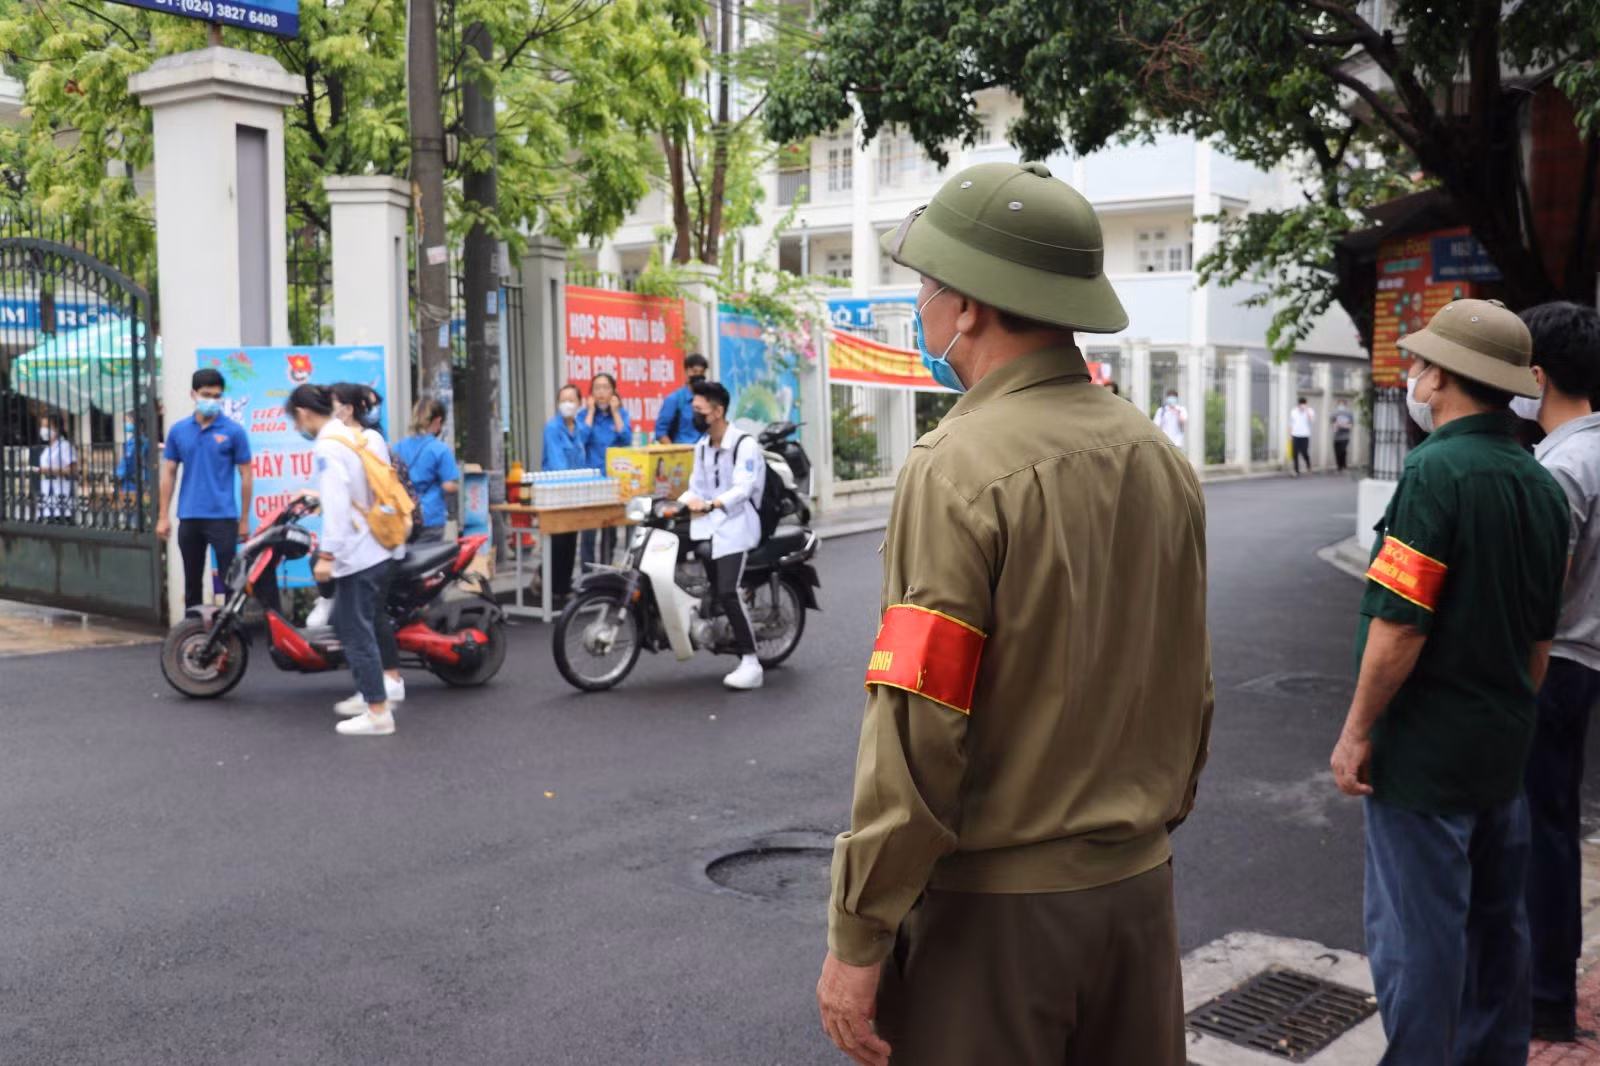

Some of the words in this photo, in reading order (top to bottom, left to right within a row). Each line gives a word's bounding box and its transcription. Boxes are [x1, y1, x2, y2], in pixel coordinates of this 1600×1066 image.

[216, 4, 246, 21] 3827
[248, 11, 278, 28] 6408
[597, 315, 627, 341] SINH
[251, 450, 284, 478] HÃY
[290, 450, 314, 481] TỰ
